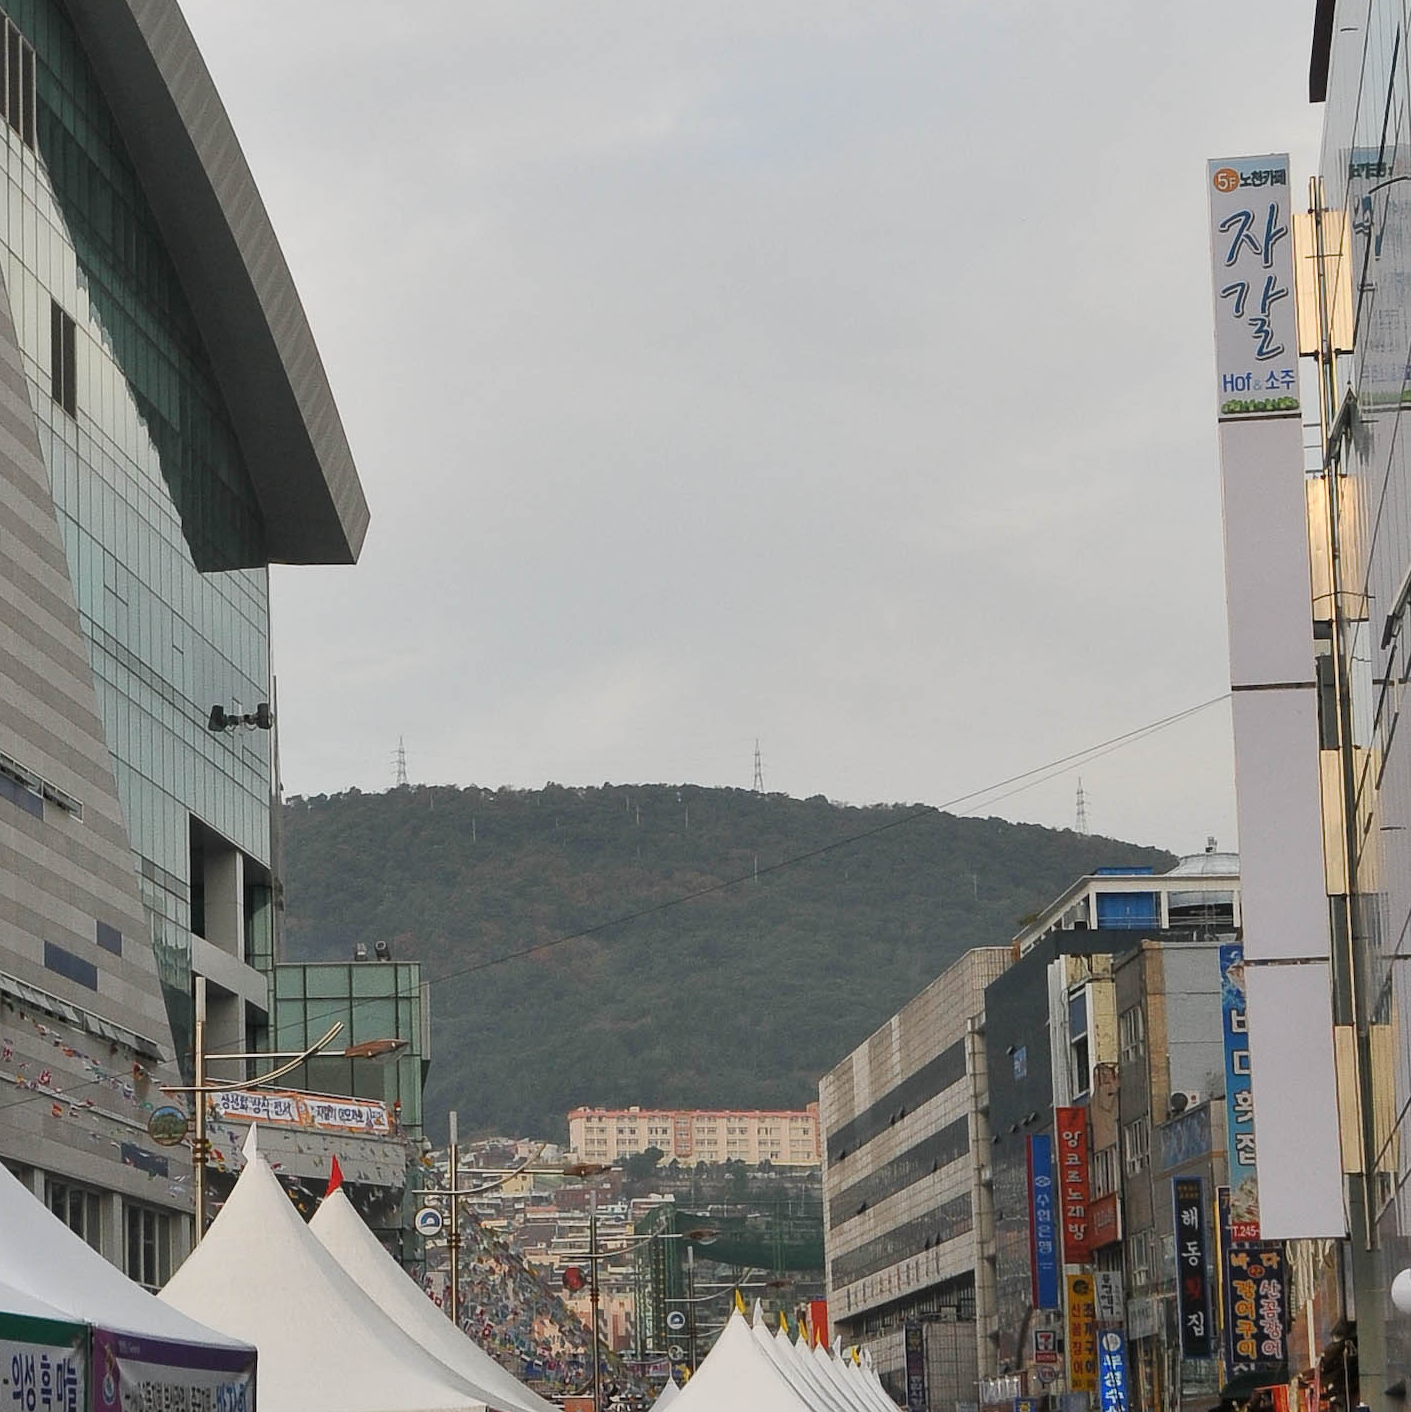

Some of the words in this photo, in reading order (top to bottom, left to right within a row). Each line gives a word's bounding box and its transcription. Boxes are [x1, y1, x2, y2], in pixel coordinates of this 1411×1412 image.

[1215, 173, 1237, 189] 5F
[1239, 168, 1286, 188] 노천카페
[1219, 202, 1288, 360] 자갈
[1222, 372, 1252, 392] Hof
[1265, 369, 1296, 391] 소주
[1063, 1130, 1086, 1240] 앙코르노래방
[11, 1352, 36, 1412] 의성
